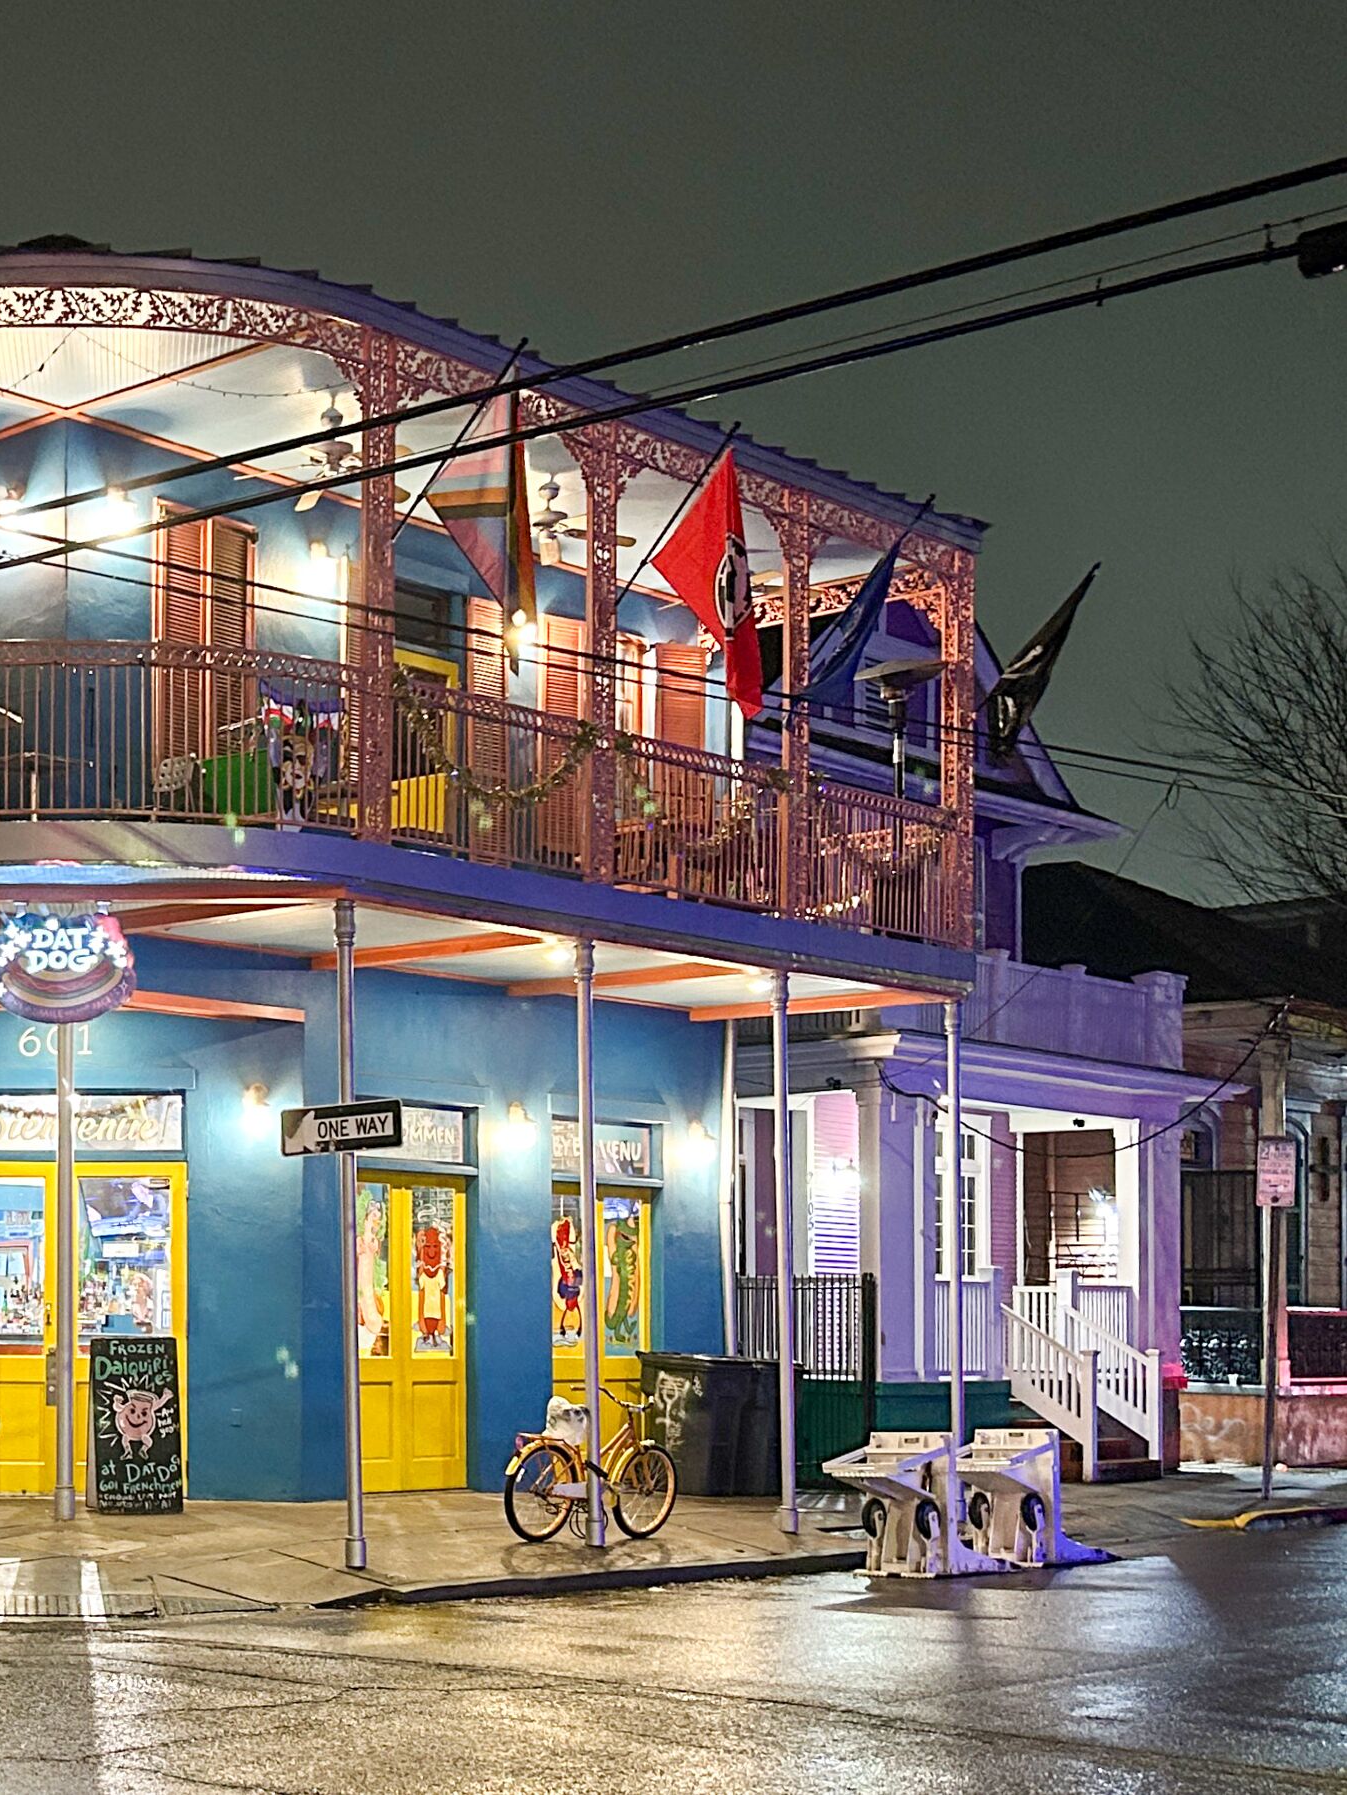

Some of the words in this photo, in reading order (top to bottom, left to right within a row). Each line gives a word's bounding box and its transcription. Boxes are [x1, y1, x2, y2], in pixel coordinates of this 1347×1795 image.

[32, 929, 88, 950] DAT
[26, 950, 98, 974] DOG
[317, 1119, 349, 1139] ONE
[355, 1115, 389, 1135] WAY
[109, 1340, 165, 1356] FROZEN
[101, 1459, 116, 1475] at
[125, 1462, 156, 1483] DAT
[99, 1480, 119, 1492] 601
